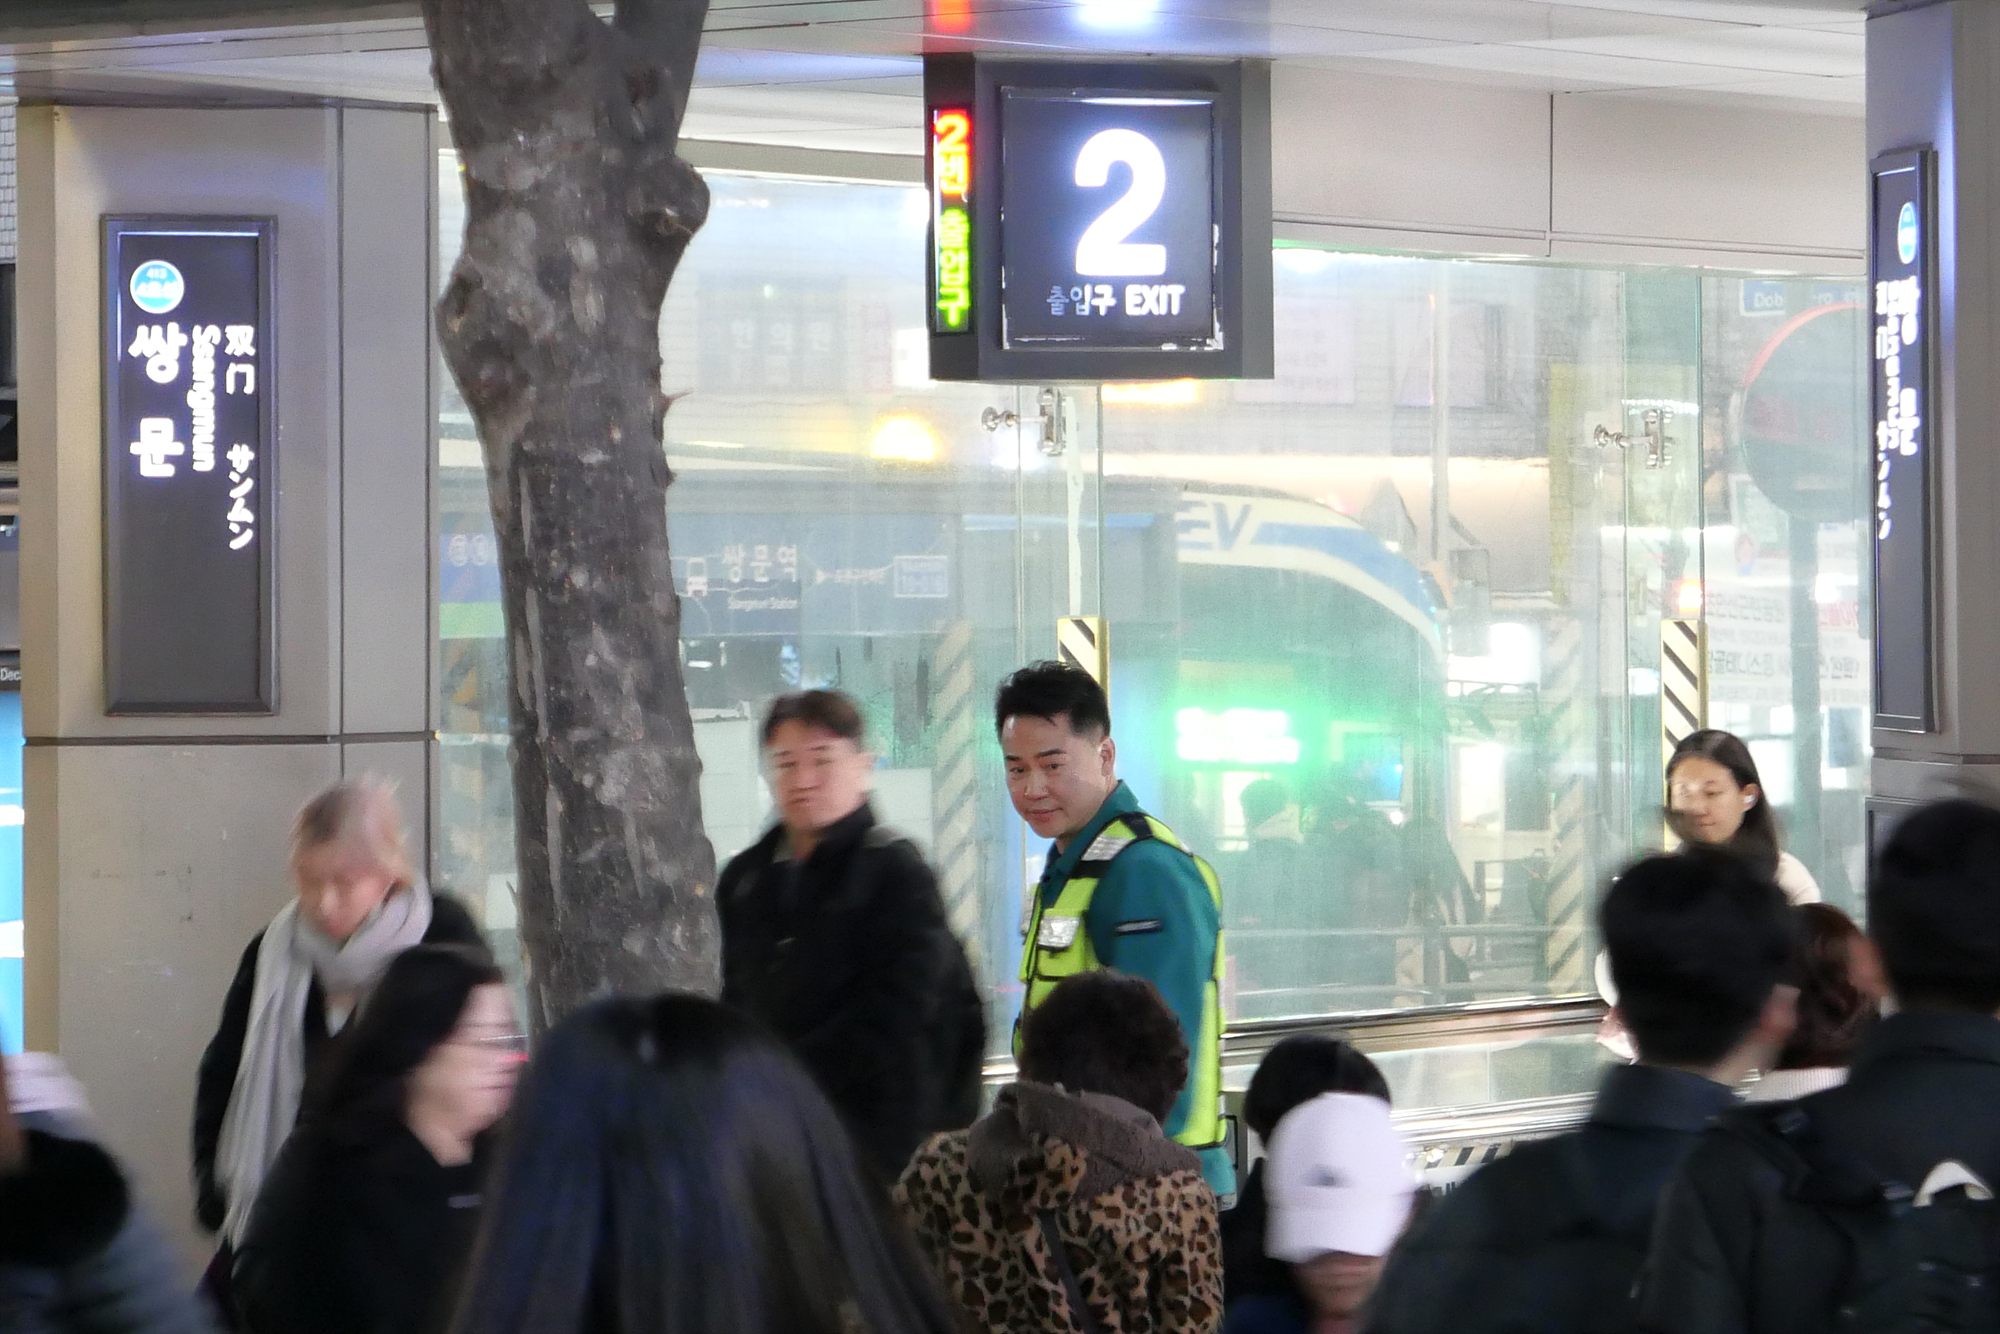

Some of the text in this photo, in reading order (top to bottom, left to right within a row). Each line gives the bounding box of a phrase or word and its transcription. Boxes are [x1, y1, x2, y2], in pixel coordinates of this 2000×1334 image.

[934, 113, 971, 327] 2번 출입구
[1073, 127, 1168, 276] 2
[1046, 283, 1187, 317] 출입구 EXIT
[127, 321, 189, 477] 쌍문
[186, 324, 222, 472] Ssangmun
[225, 443, 256, 550] サンムン
[722, 543, 797, 582] 쌍문역
